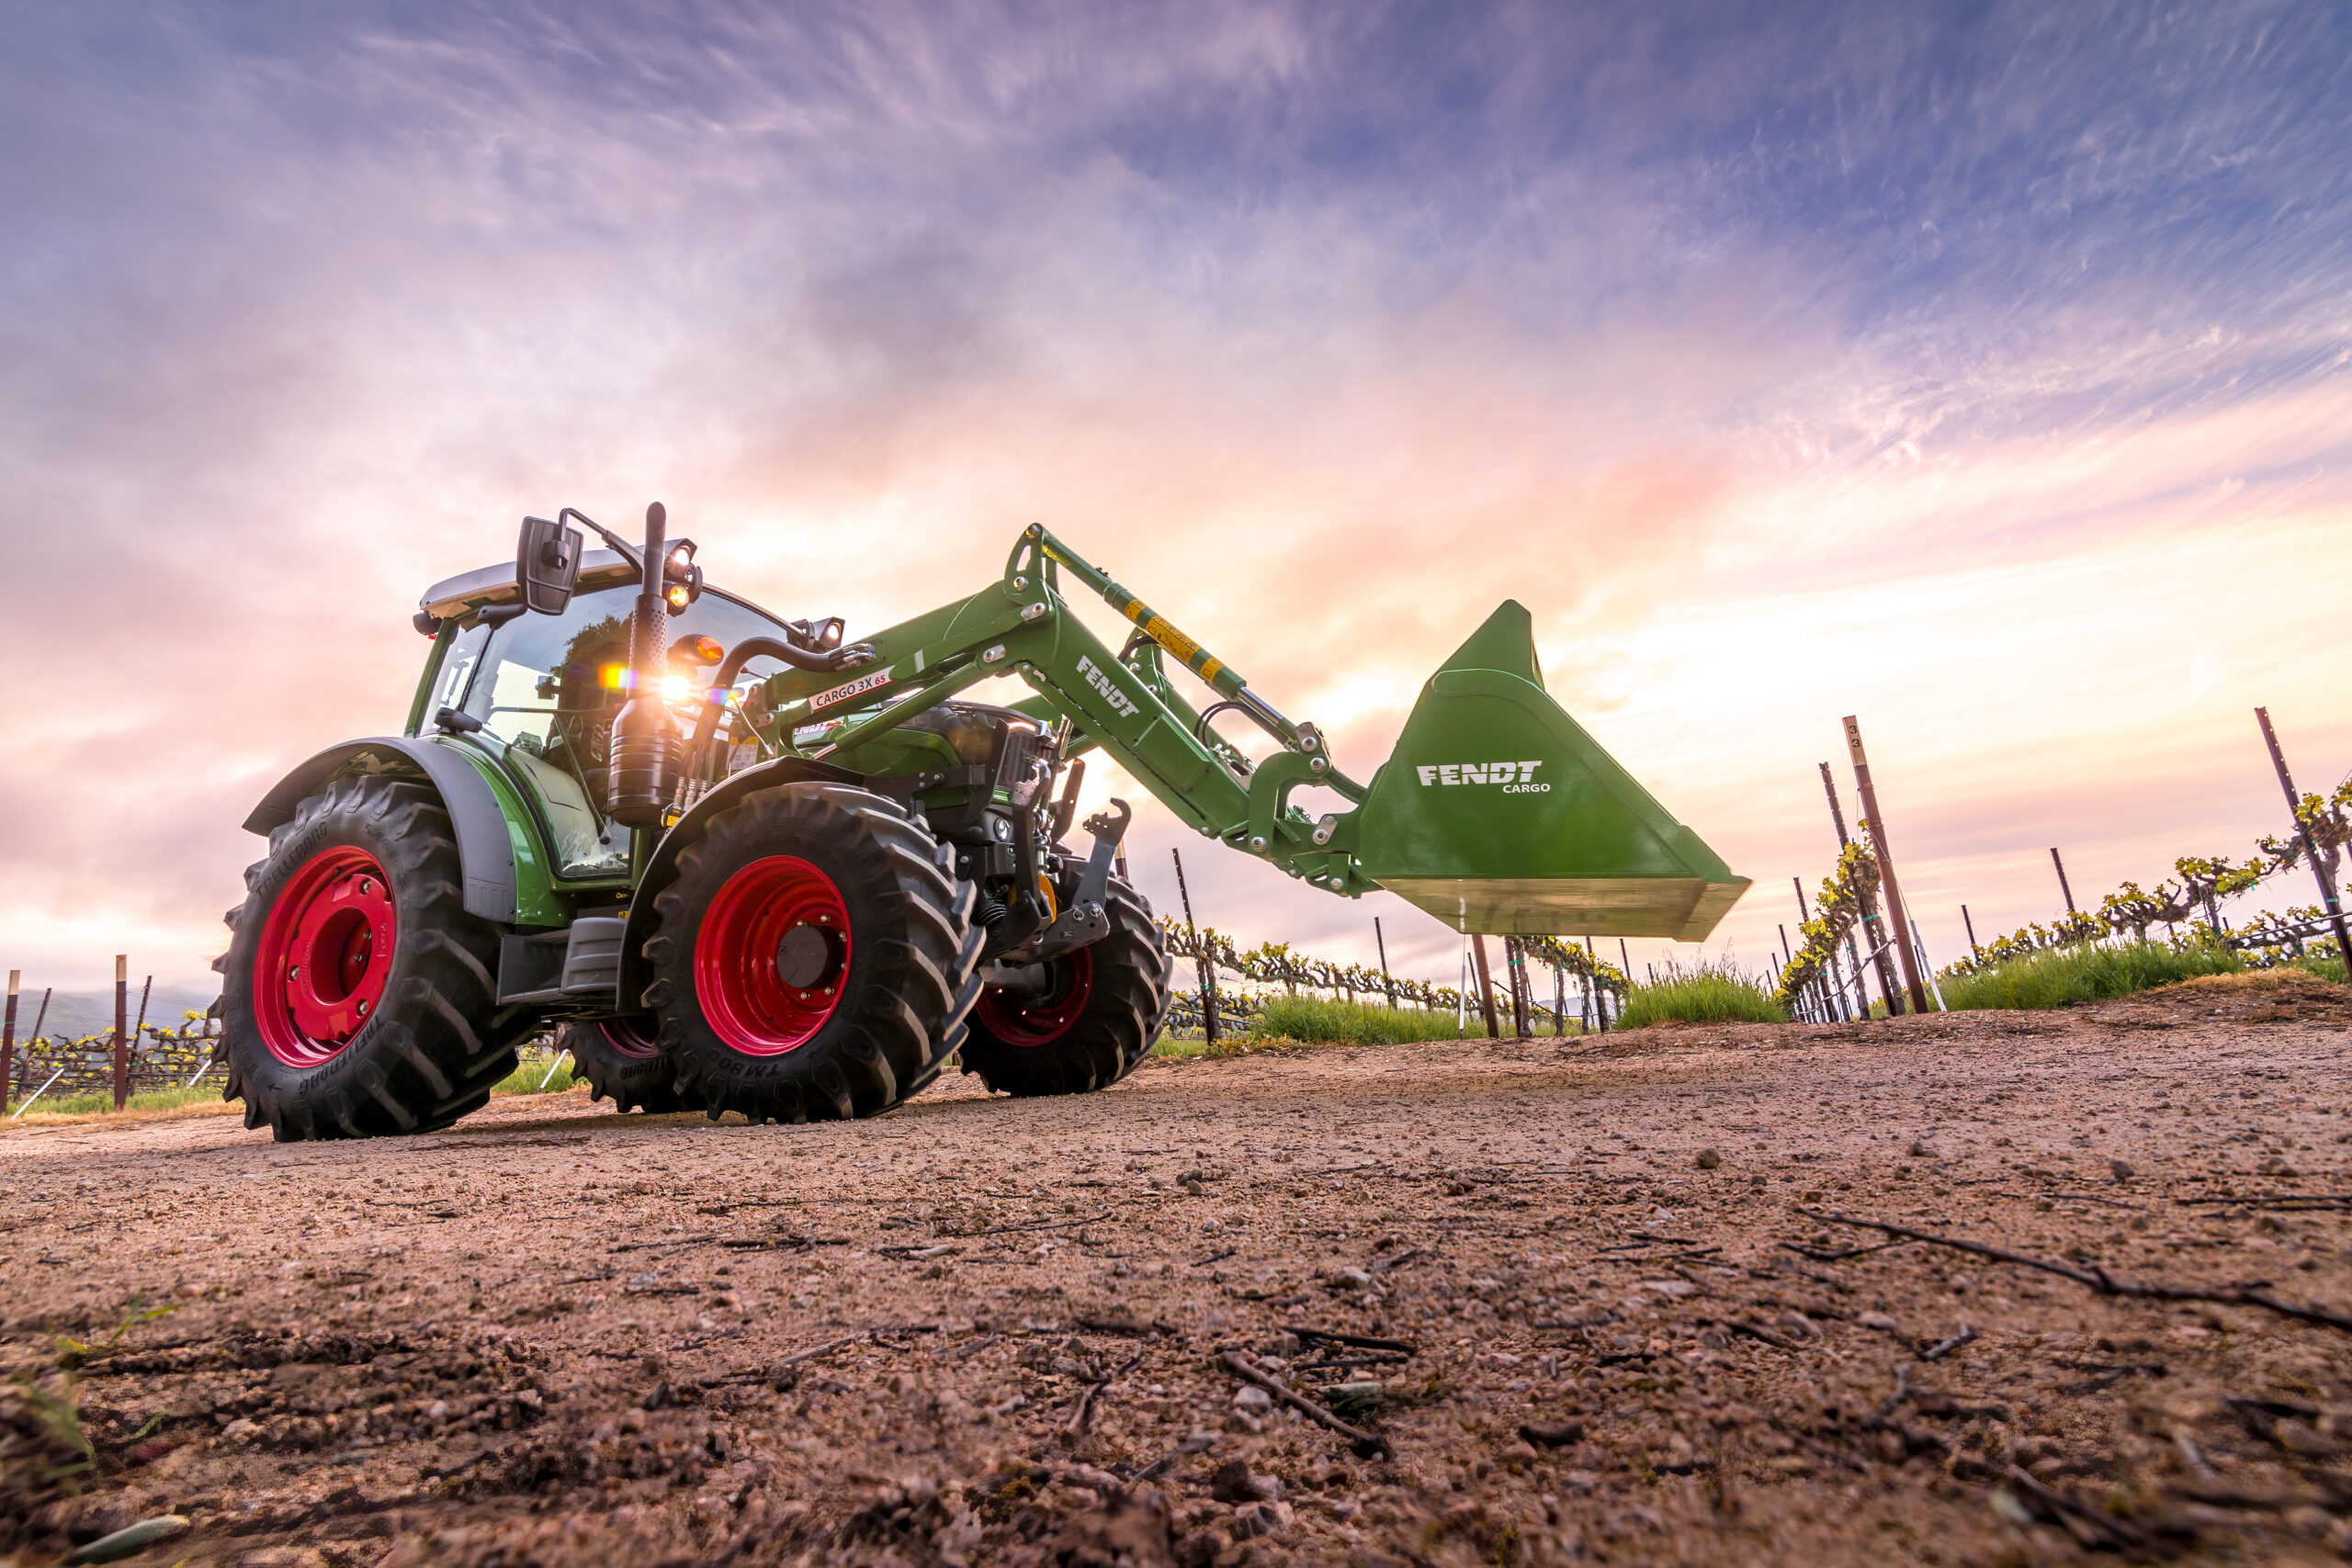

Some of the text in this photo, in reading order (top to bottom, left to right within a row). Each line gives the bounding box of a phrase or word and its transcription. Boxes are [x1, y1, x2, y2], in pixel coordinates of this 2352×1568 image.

[816, 675, 886, 706] CARGO 3X 65
[1076, 654, 1140, 717] FENDT
[1416, 761, 1543, 786] FENDT
[1502, 784, 1551, 794] CARGO
